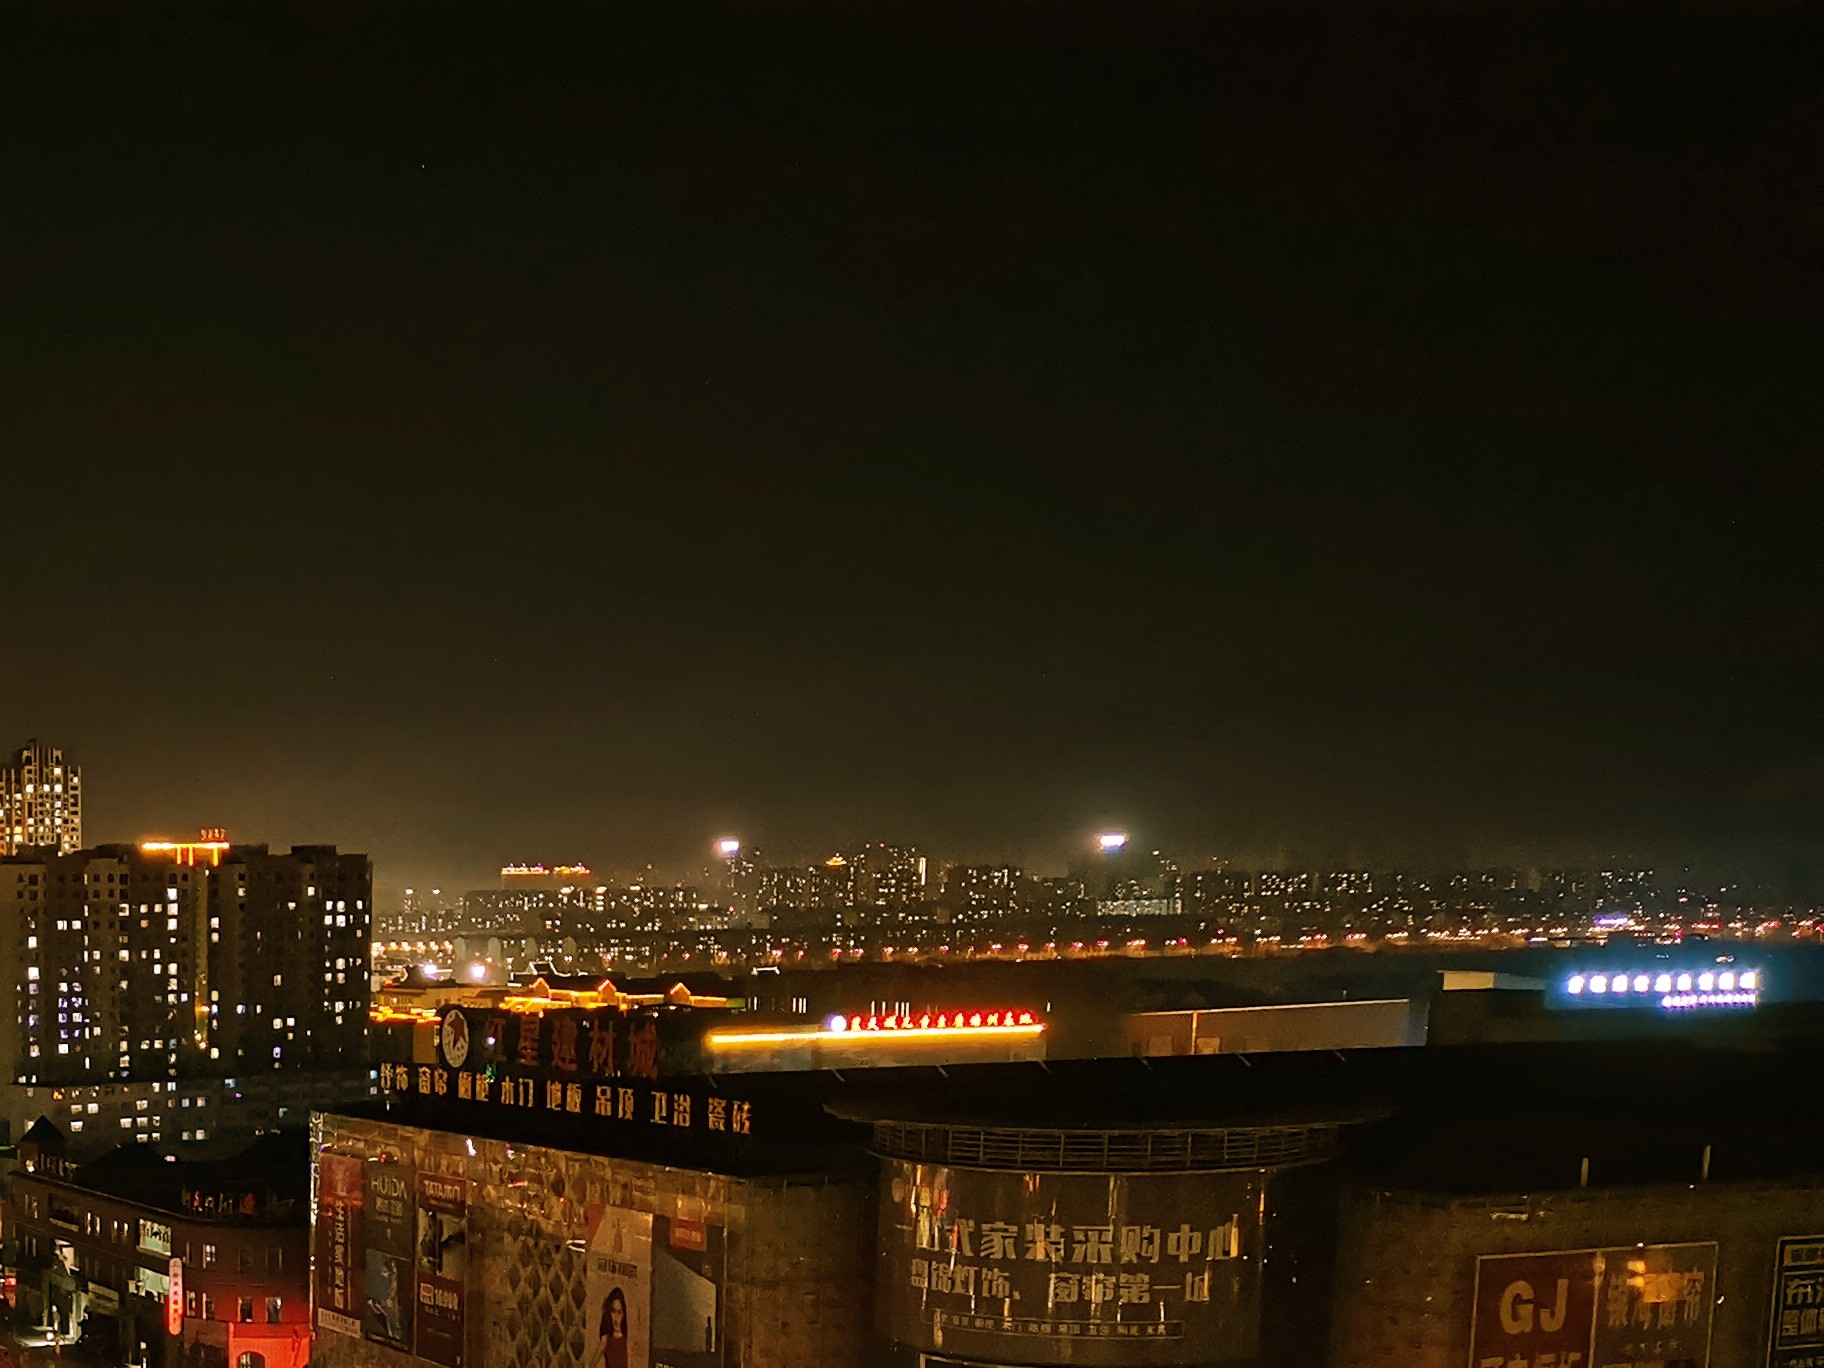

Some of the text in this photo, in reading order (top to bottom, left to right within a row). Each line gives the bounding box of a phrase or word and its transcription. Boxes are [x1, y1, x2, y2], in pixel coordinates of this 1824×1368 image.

[499, 1075, 535, 1109] 木门
[545, 1079, 584, 1114] 地板
[593, 1085, 635, 1122] 吊顶
[649, 1090, 693, 1128] 卫浴
[706, 1096, 753, 1136] 瓷砖
[1500, 1279, 1570, 1335] GJ
